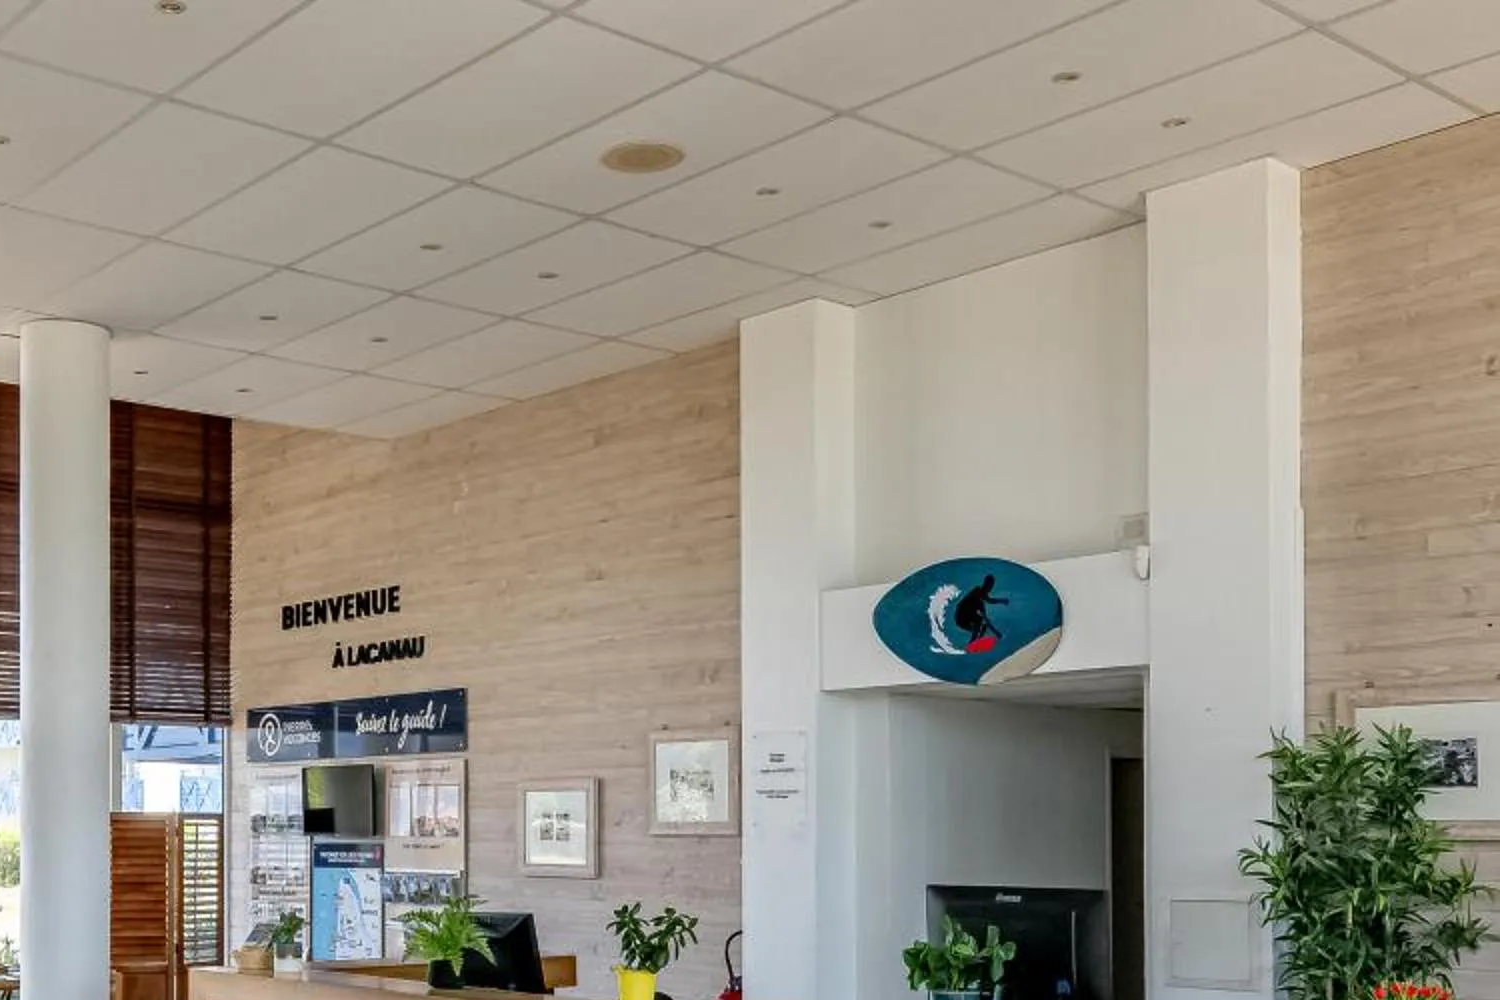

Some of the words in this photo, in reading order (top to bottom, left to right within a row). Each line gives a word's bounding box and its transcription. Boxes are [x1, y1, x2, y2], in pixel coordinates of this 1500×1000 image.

[282, 585, 401, 630] BIENVENUE
[347, 635, 425, 667] LACANAU
[356, 712, 387, 736] Suivez
[389, 708, 400, 733] le
[397, 699, 436, 749] guide
